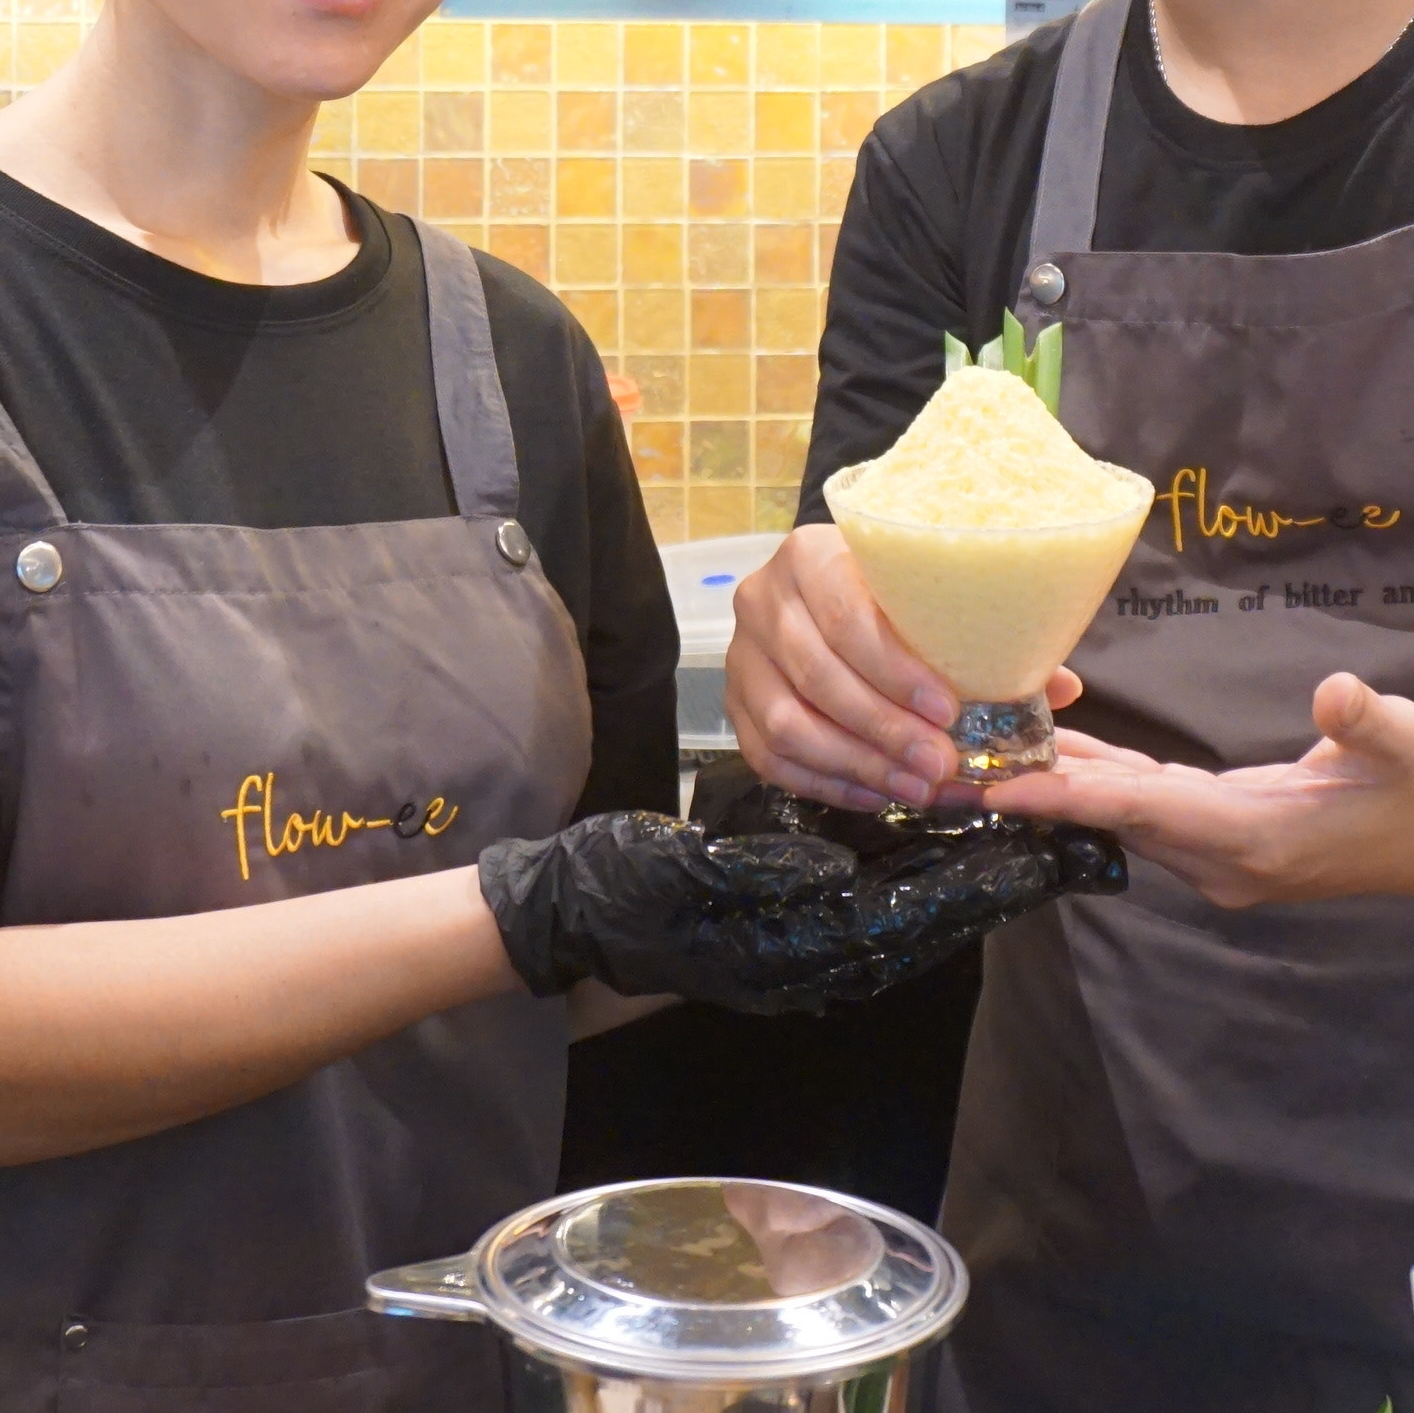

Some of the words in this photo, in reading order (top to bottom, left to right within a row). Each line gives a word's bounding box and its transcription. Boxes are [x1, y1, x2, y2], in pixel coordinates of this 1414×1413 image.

[1116, 588, 1219, 620] rhythm
[1238, 584, 1270, 612] of
[1285, 583, 1365, 609] bitter
